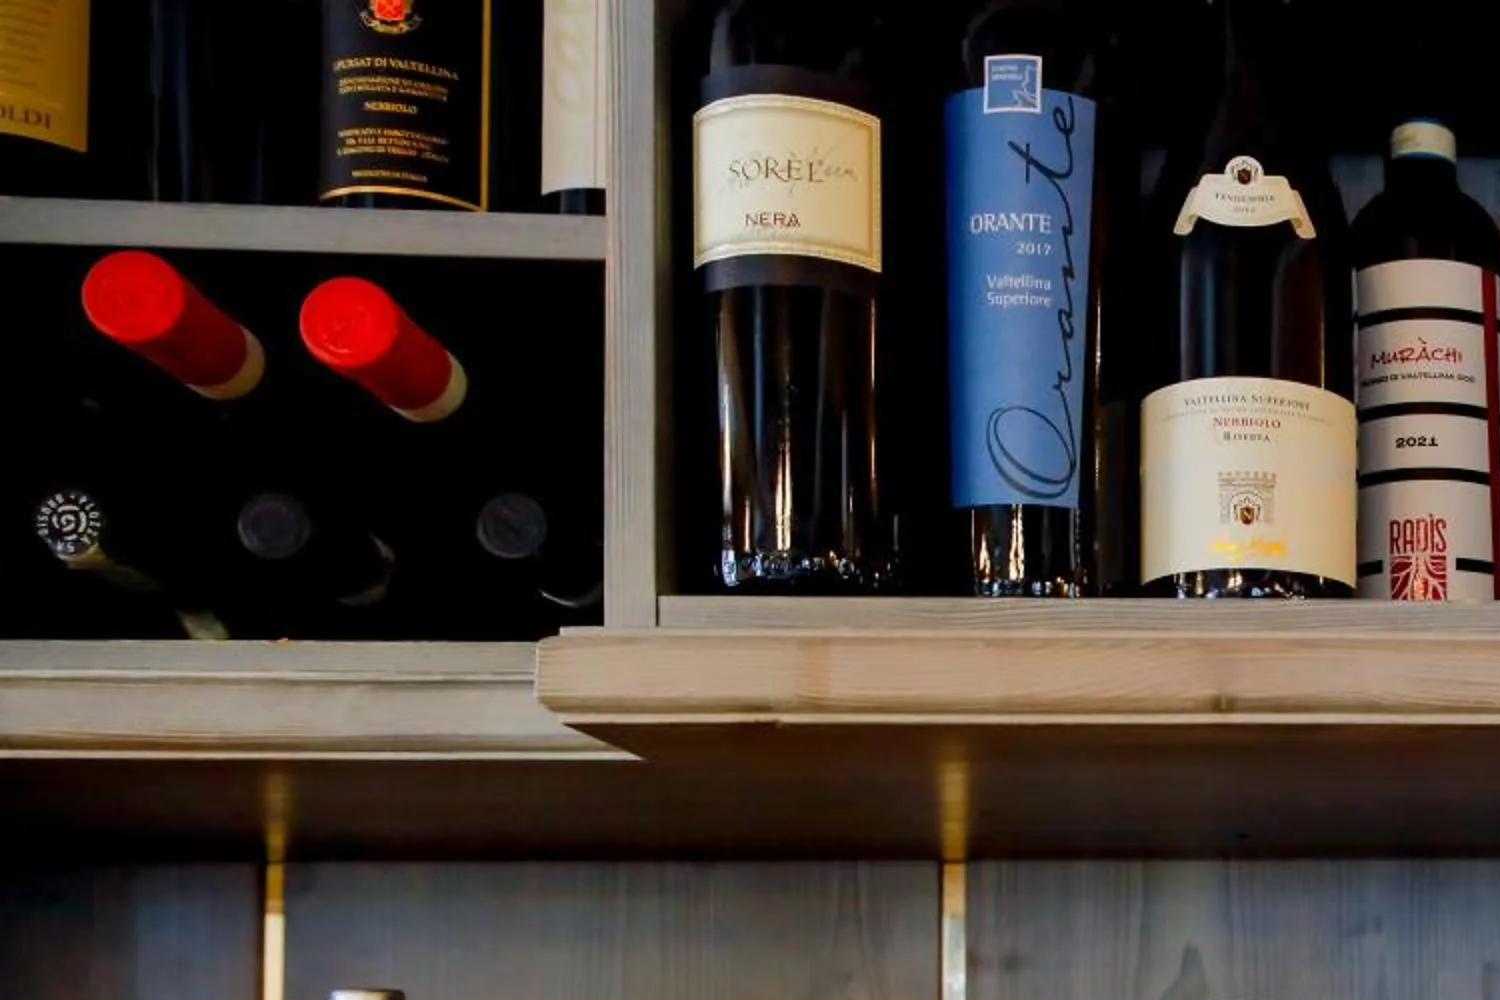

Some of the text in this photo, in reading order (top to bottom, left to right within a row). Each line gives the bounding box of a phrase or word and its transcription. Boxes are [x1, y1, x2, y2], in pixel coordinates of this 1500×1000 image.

[745, 212, 801, 228] NERA
[971, 213, 1053, 234] ORANTE
[986, 273, 1052, 291] Valtellina
[986, 291, 1052, 309] Superiore
[1395, 435, 1439, 449] 2021
